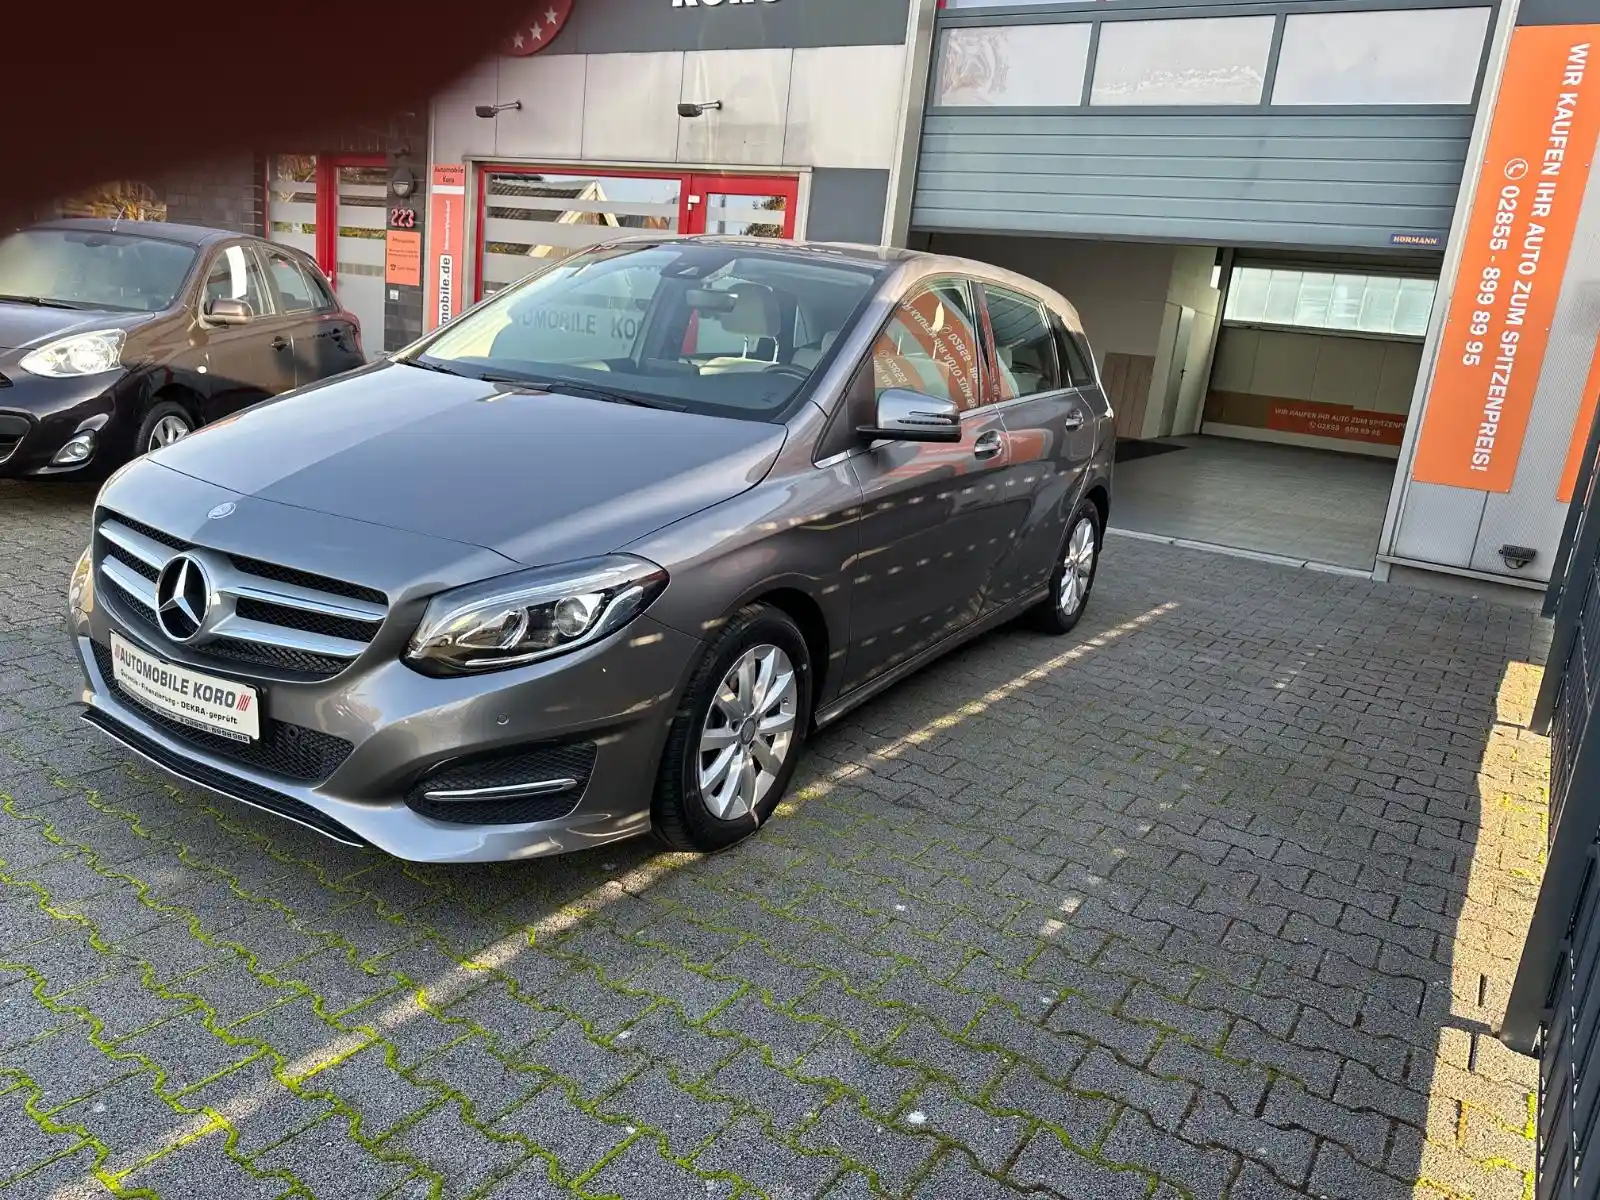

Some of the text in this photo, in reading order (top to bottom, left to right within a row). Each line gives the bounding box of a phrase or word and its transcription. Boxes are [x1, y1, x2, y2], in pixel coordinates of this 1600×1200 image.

[391, 208, 416, 228] 223
[1489, 185, 1520, 250] 02855
[1470, 43, 1591, 472] WIR KAUFEN IHR AUTO ZUM SPITZENPREIS!
[441, 257, 451, 327] mobile.de
[1477, 266, 1501, 305] 899
[1470, 310, 1491, 336] 89
[1463, 341, 1484, 366] 95
[120, 647, 190, 696] AUTOMOBILE
[193, 681, 237, 709] KORO
